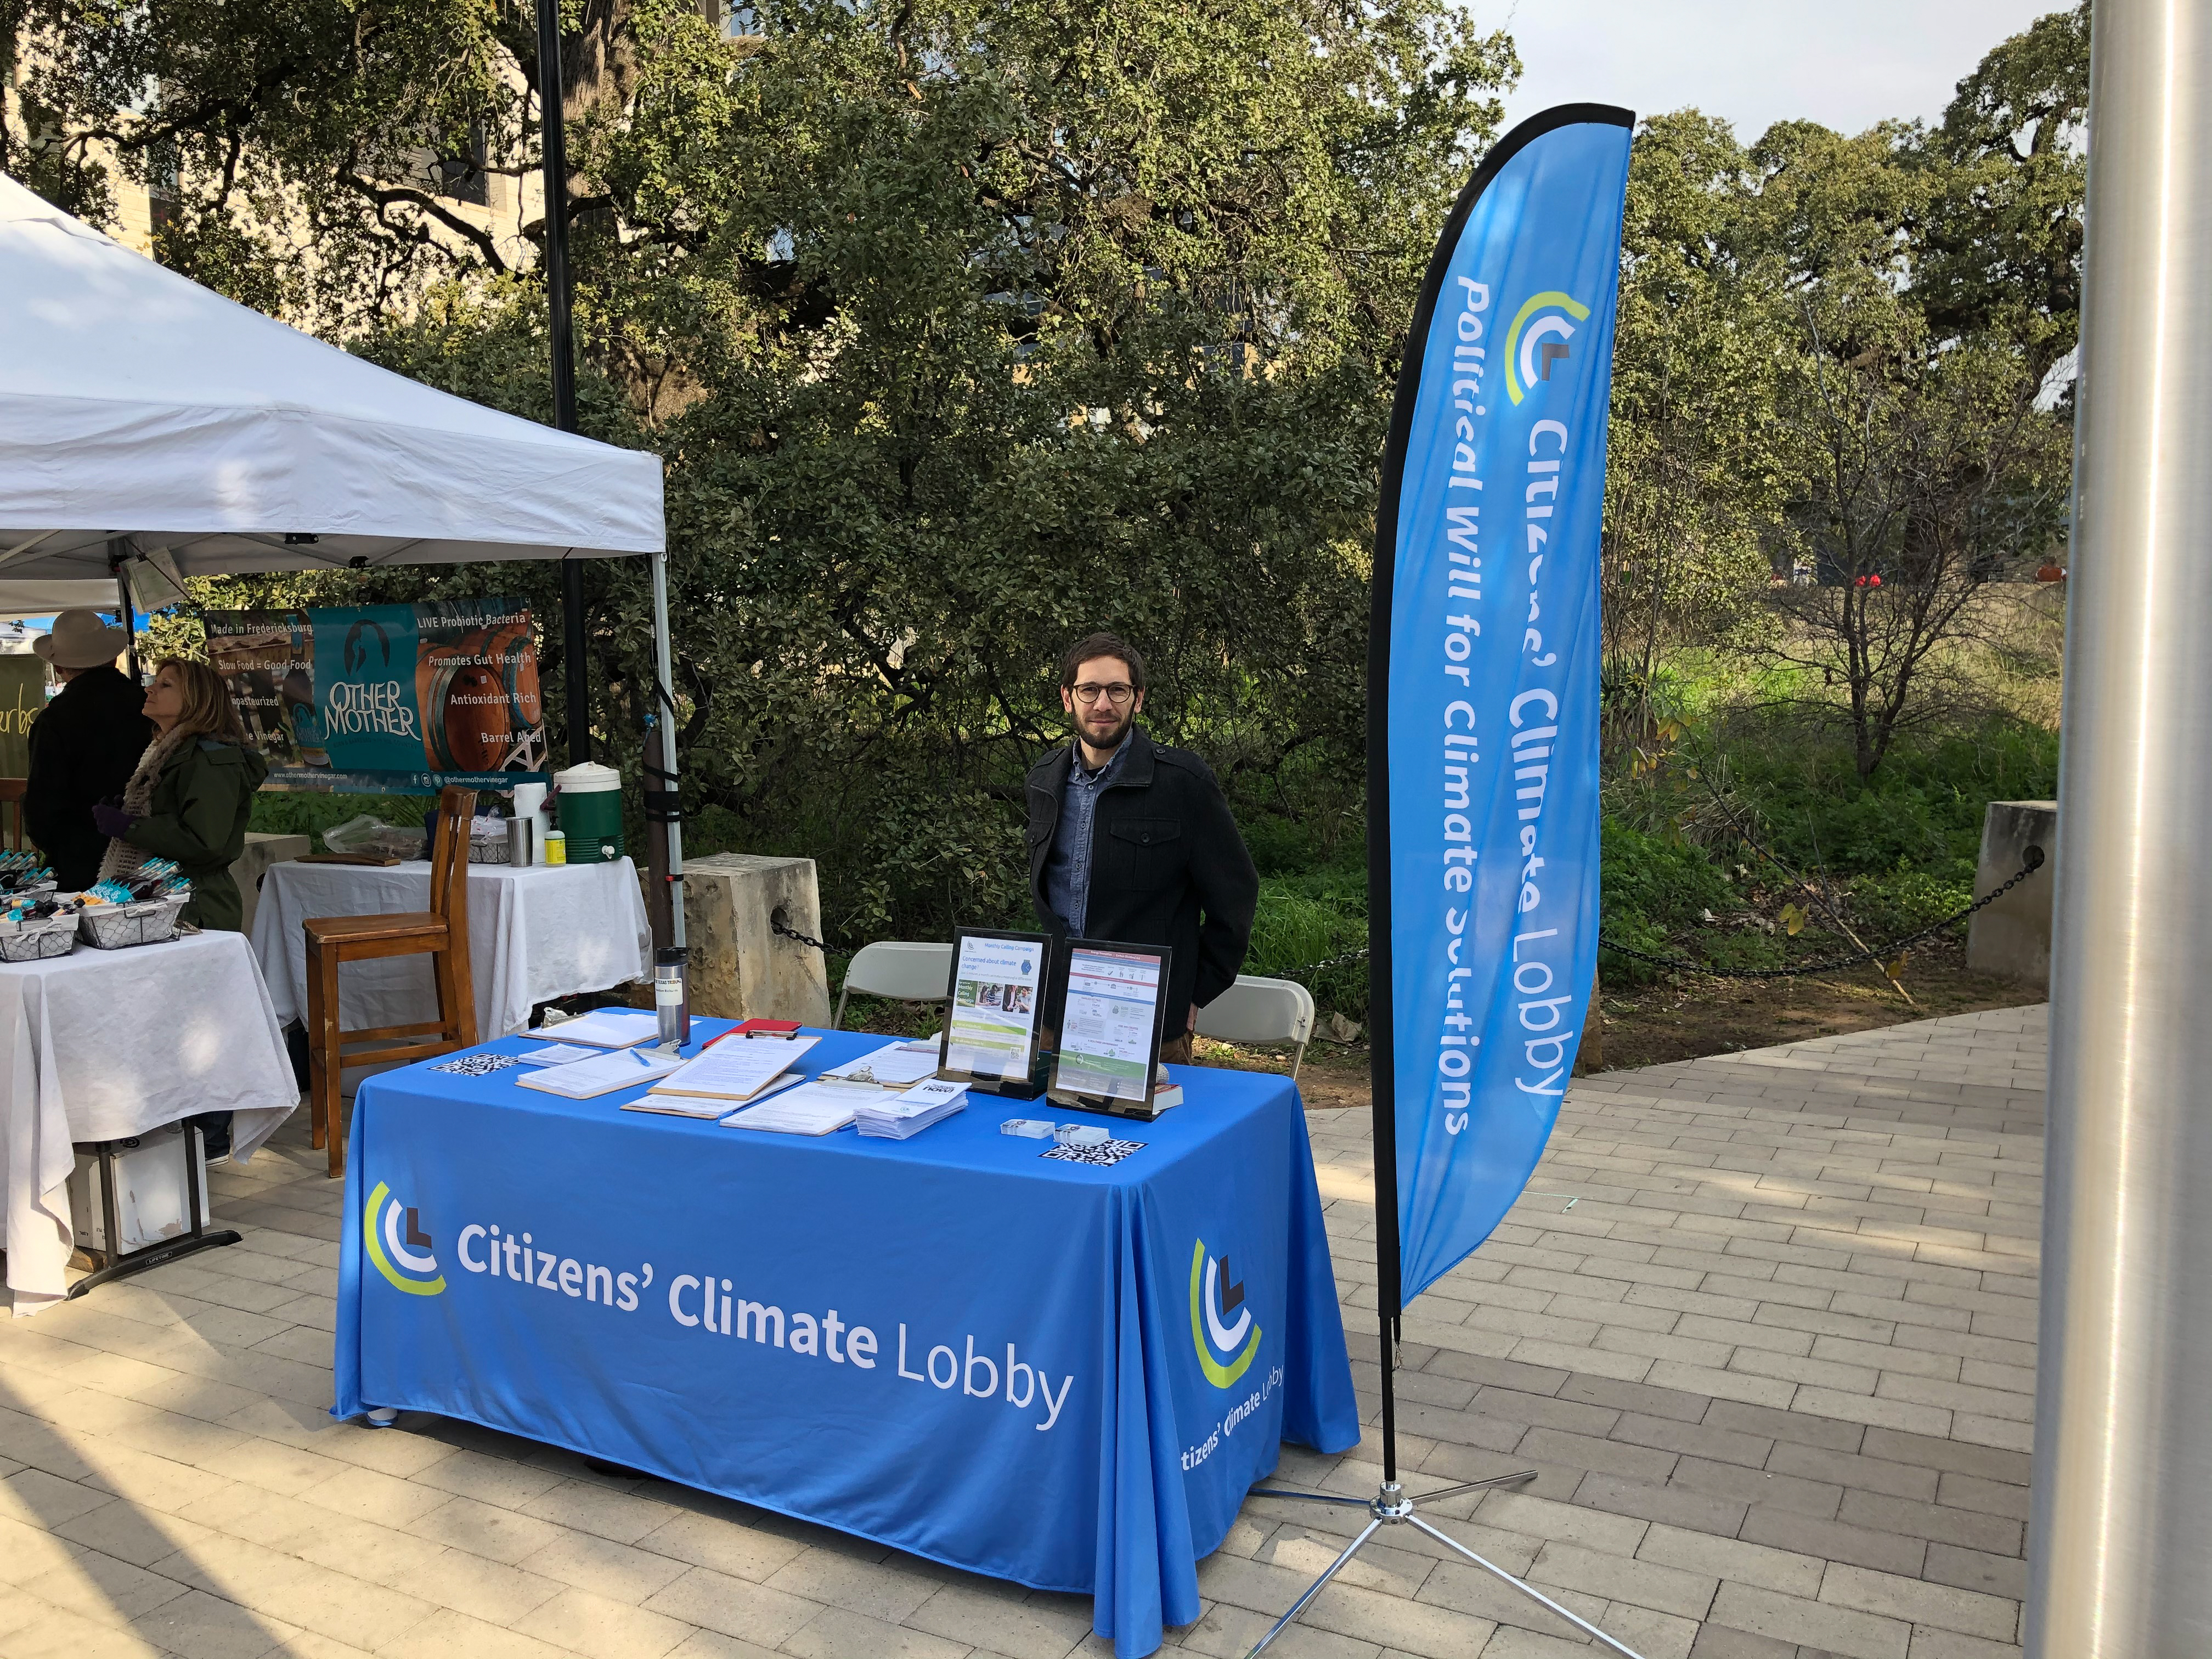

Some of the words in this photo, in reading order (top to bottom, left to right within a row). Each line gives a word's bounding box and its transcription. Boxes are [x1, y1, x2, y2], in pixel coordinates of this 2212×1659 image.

[1449, 275, 1489, 492] Political
[1445, 506, 1482, 600] Will
[211, 624, 233, 634] Made
[235, 624, 244, 634] in
[247, 623, 314, 635] Fredericksburg
[417, 617, 439, 628] LIVE
[441, 615, 483, 627] Probiotic
[486, 612, 526, 625] Bacteria
[218, 661, 236, 670] Slow
[237, 660, 255, 670] Food
[264, 661, 287, 669] Good
[290, 659, 311, 669] Food
[428, 656, 471, 666] Promotes
[474, 654, 493, 665] Gut
[496, 652, 532, 664] Health
[1444, 614, 1481, 687] for
[231, 696, 279, 707] npasteurized
[330, 681, 405, 715] OTHER
[450, 693, 510, 704] Antioxidant
[513, 692, 537, 703] Rich
[253, 731, 284, 743] Vinegar
[324, 706, 421, 741] MOTHER
[481, 732, 514, 743] Barrel
[1509, 688, 1559, 915] Climate
[1511, 928, 1573, 1096] Lobby
[458, 1224, 654, 1312] Citizens’
[668, 1273, 879, 1369] Climate
[898, 1323, 1074, 1431] Lobby
[1181, 1422, 1220, 1471] tizens’
[1224, 1391, 1260, 1437] Climate
